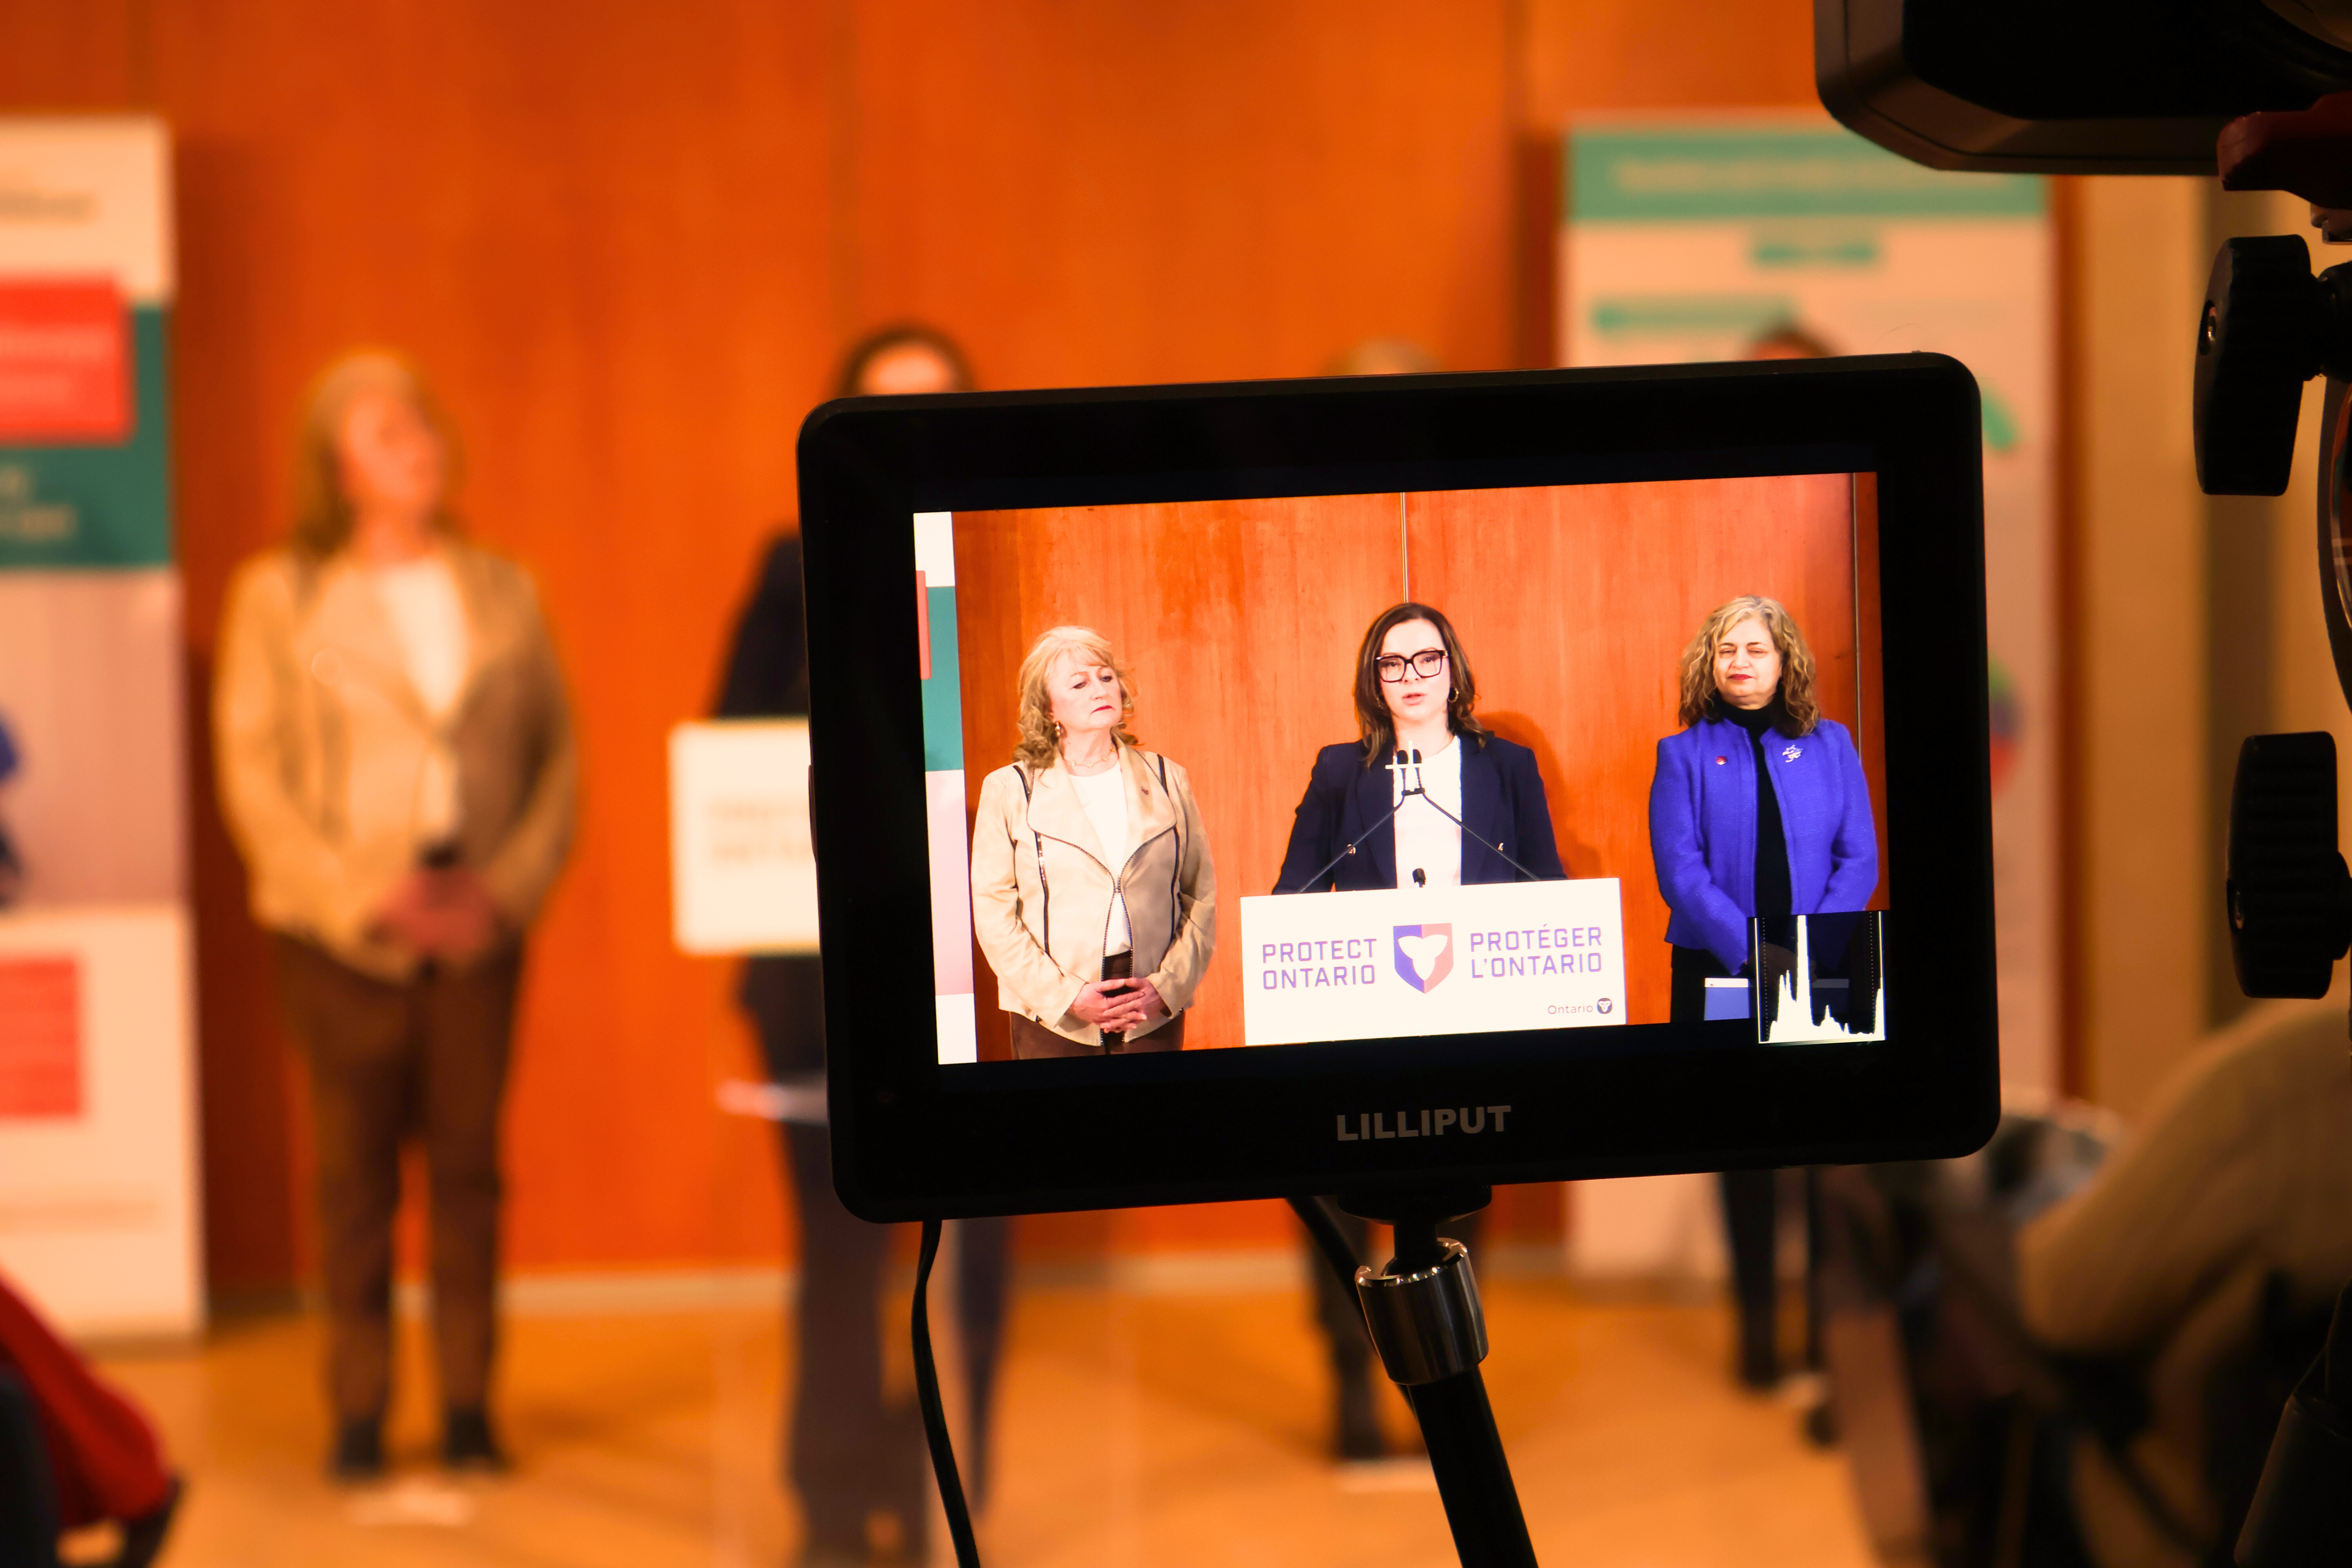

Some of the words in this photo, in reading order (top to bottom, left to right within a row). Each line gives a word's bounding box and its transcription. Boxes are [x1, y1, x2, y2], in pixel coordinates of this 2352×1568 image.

[1470, 924, 1602, 952] PROTÉGER
[1263, 938, 1377, 964] PROTECT
[1263, 965, 1375, 990] ONTARIO
[1471, 953, 1602, 978] L'ONTARIO
[1548, 1004, 1593, 1014] Ontario
[1337, 1105, 1511, 1141] LILLIPUT
